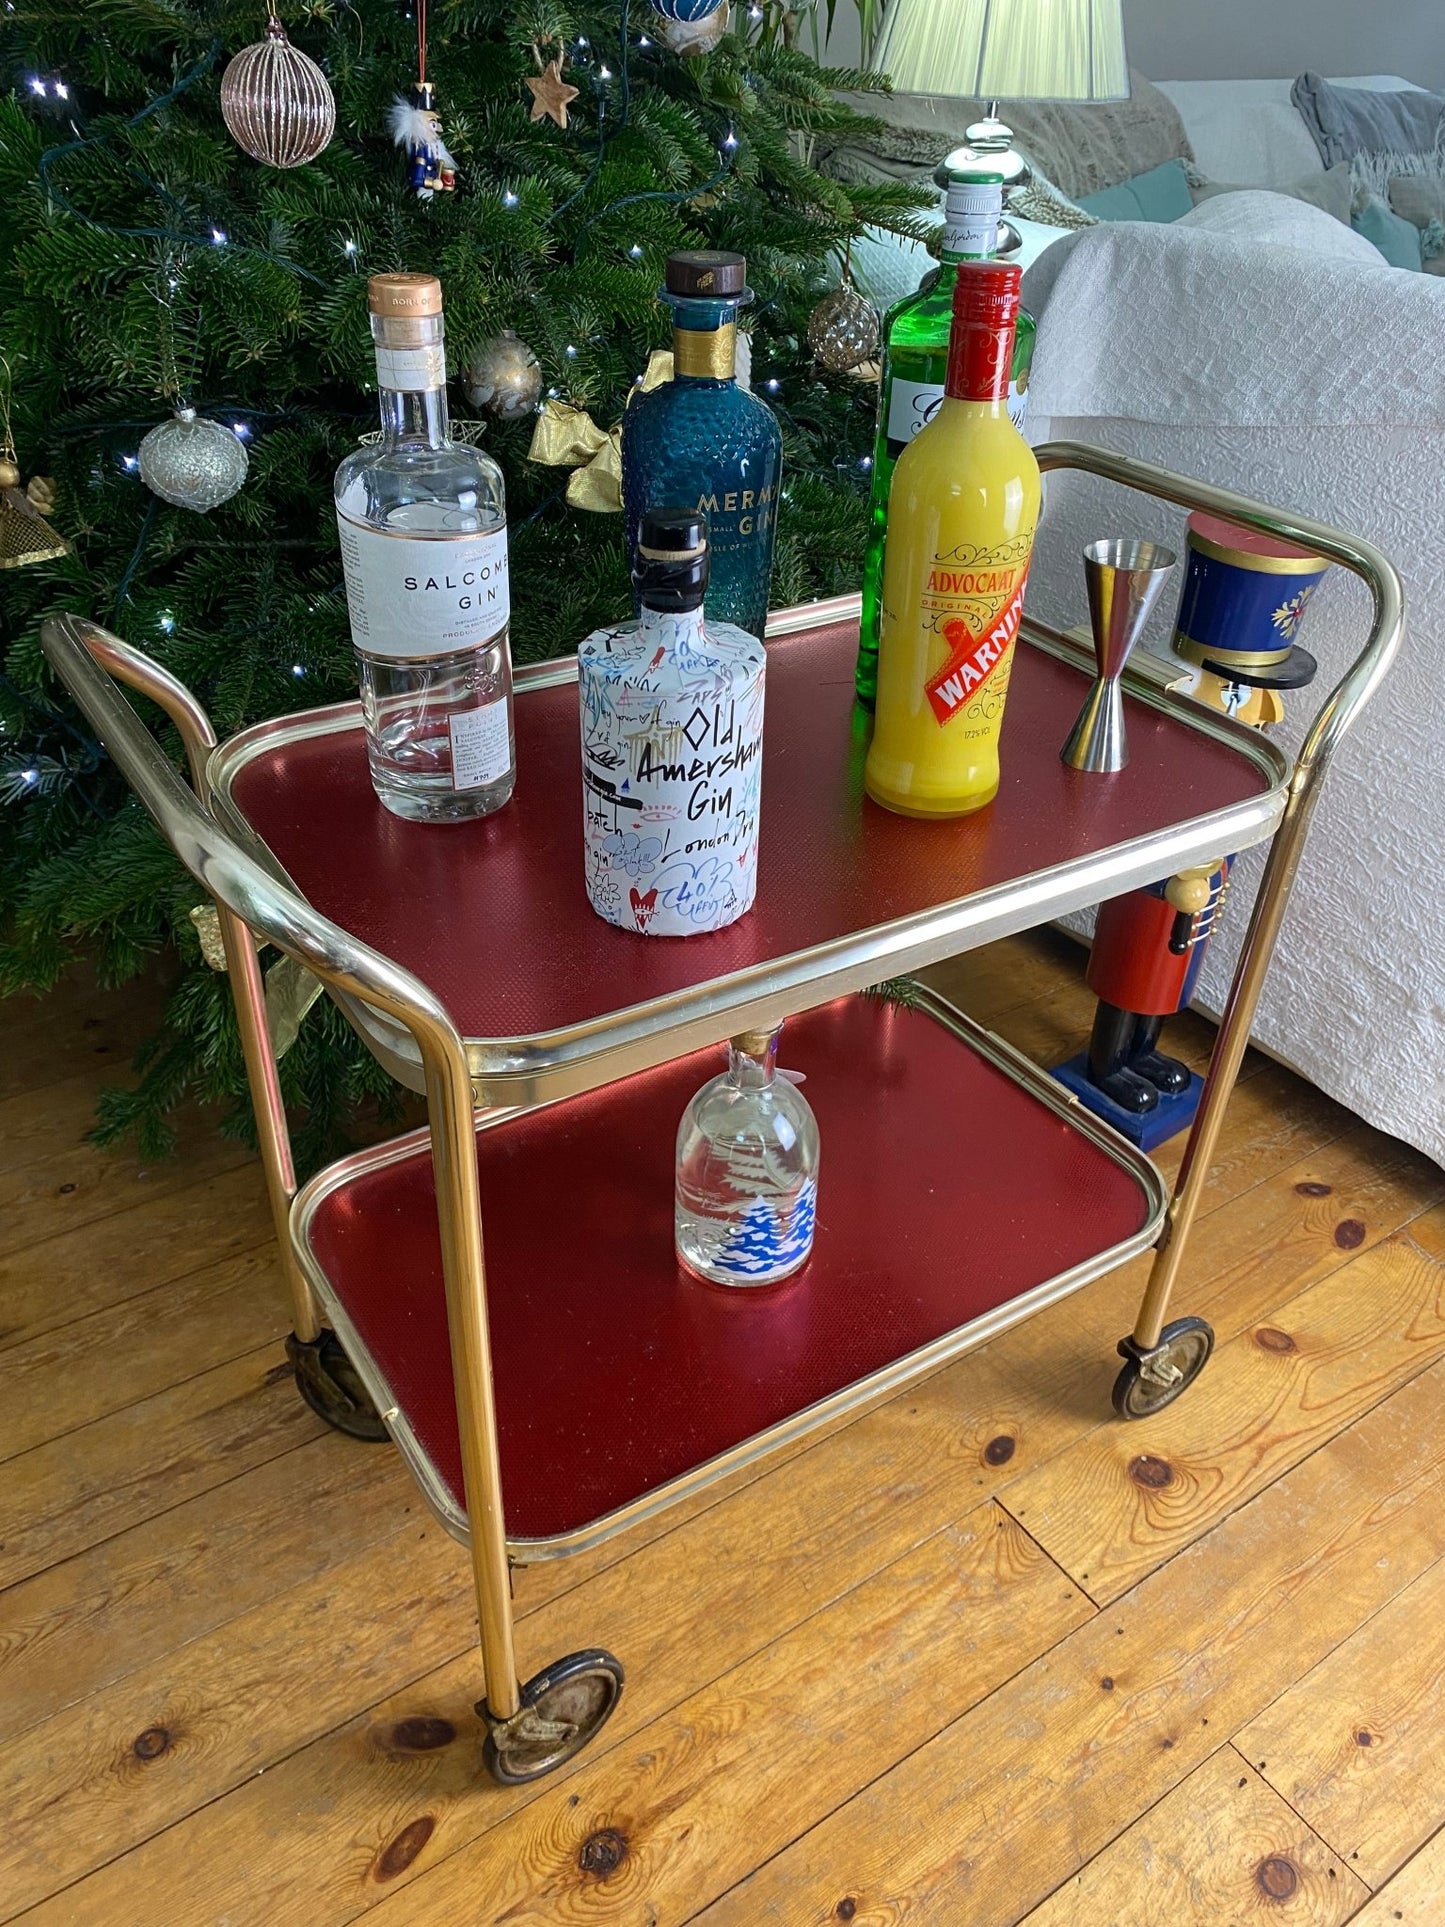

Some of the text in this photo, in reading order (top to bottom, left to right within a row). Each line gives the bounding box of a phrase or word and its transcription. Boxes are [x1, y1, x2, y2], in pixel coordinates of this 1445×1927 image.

[739, 511, 773, 536] GIN
[928, 568, 1017, 594] ADVOCAAT
[459, 586, 496, 610] GIN
[921, 598, 988, 619] ORIGINAL
[665, 719, 681, 742] gin
[682, 699, 734, 751] Old
[687, 781, 734, 821] Gin
[661, 818, 730, 863] London
